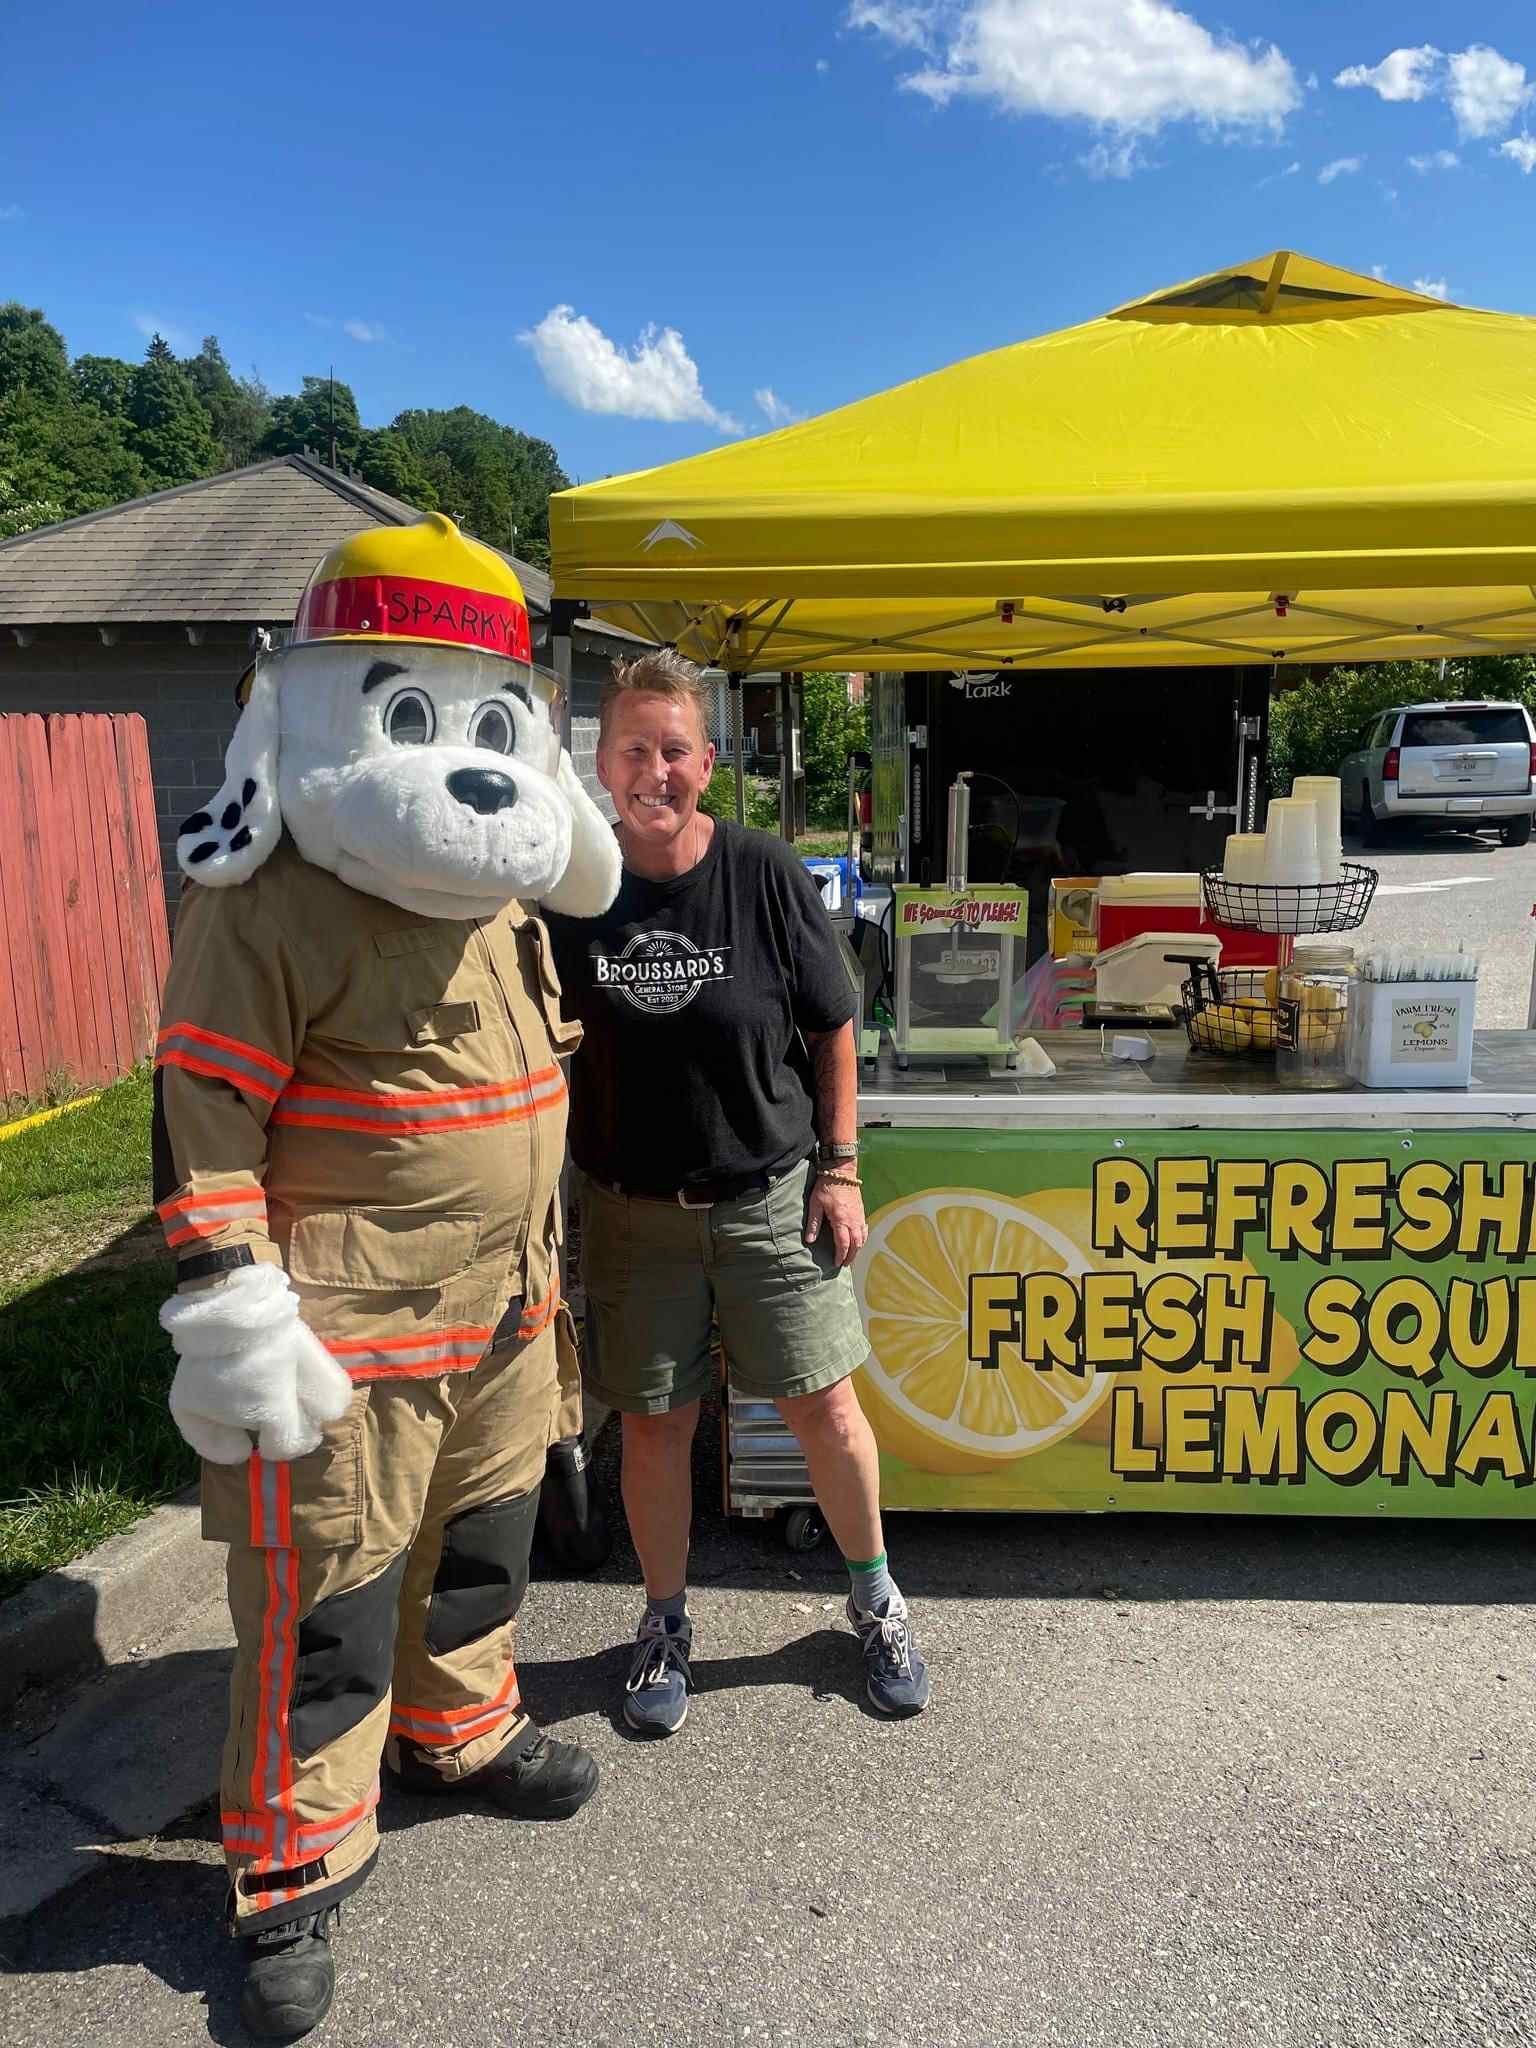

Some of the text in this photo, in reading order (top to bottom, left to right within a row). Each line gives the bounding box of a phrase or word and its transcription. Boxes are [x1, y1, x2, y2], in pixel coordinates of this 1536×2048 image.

[903, 902, 919, 923] WE
[966, 902, 980, 922] TO
[980, 901, 1020, 922] PLEASE!
[597, 952, 724, 981] BROUSSARD'S
[634, 983, 689, 993] GENERAL STORE
[1092, 1156, 1536, 1265] REFRESH
[968, 1271, 1275, 1377] FRESH
[1110, 1384, 1536, 1488] LEMONA
